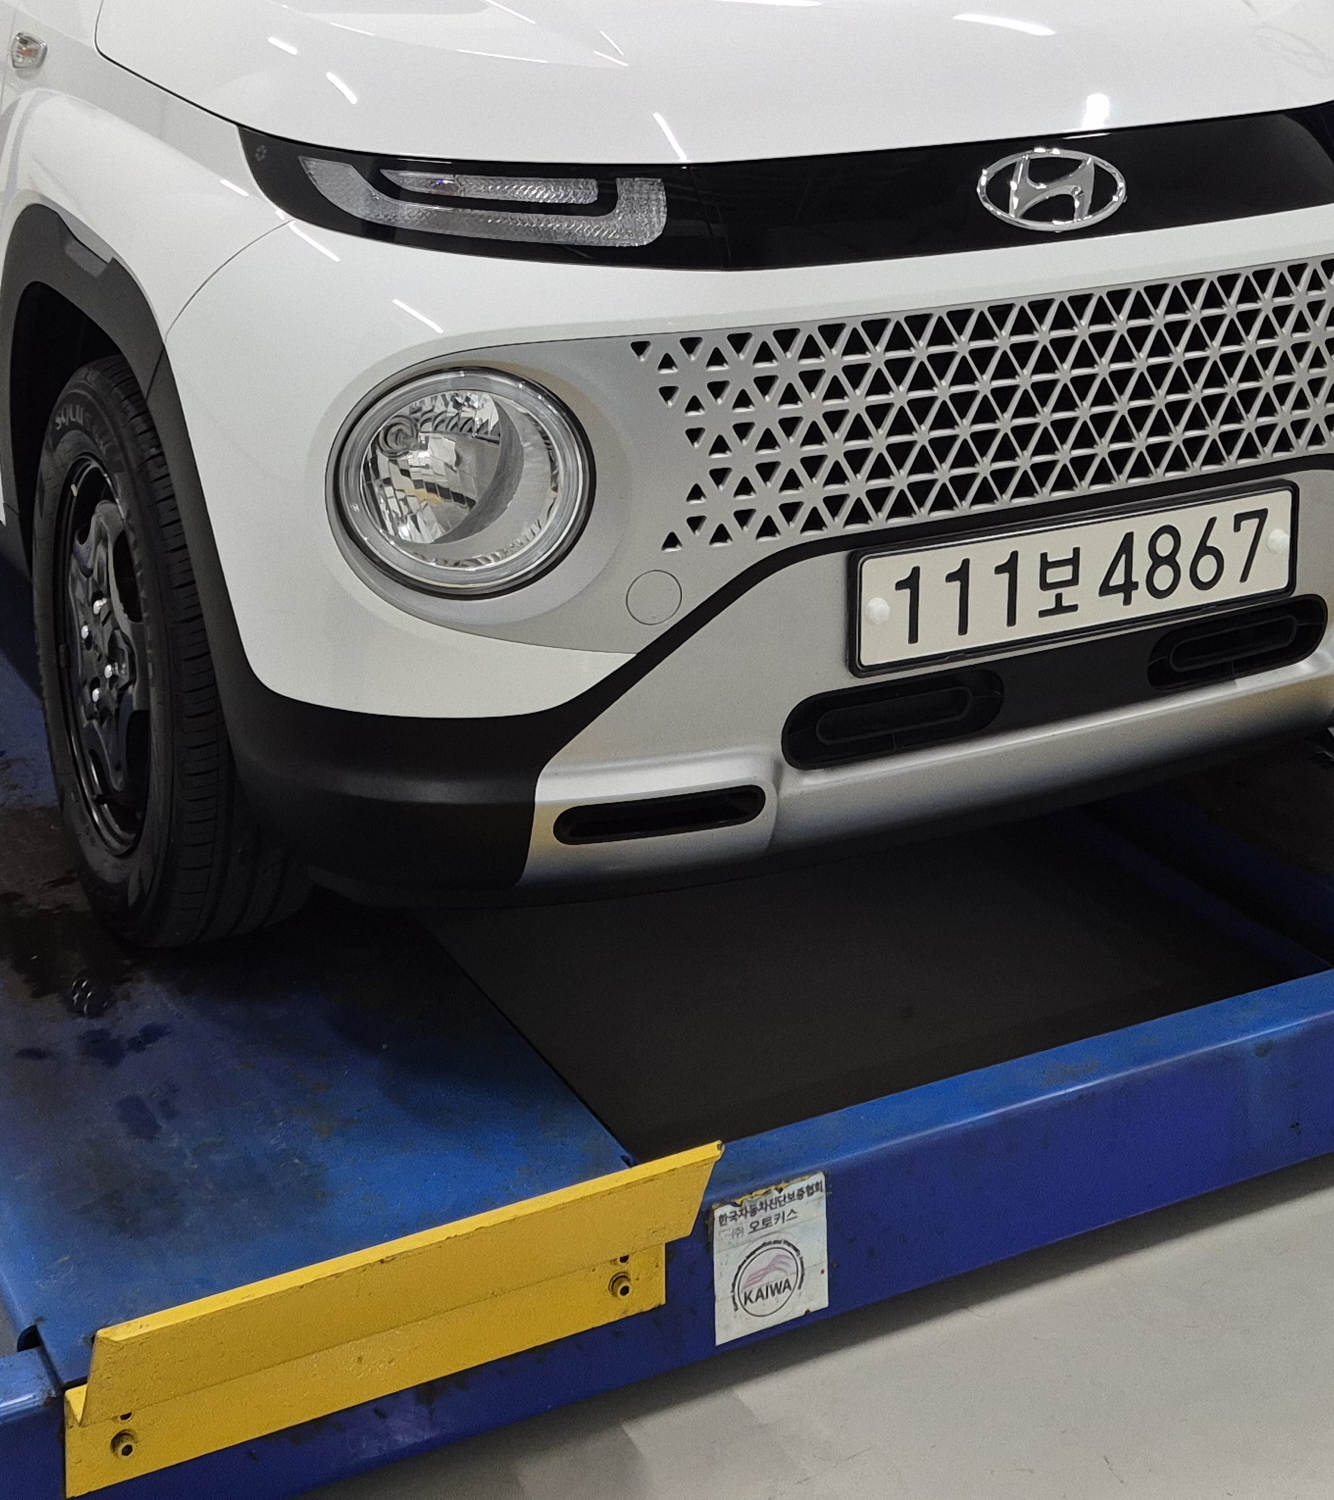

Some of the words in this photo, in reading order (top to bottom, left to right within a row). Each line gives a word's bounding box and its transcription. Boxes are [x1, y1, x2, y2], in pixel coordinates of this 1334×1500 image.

[894, 507, 1269, 645] 111보4867
[718, 1179, 824, 1227] 한국자동차진단보증협회
[744, 1278, 792, 1307] KAIWA
